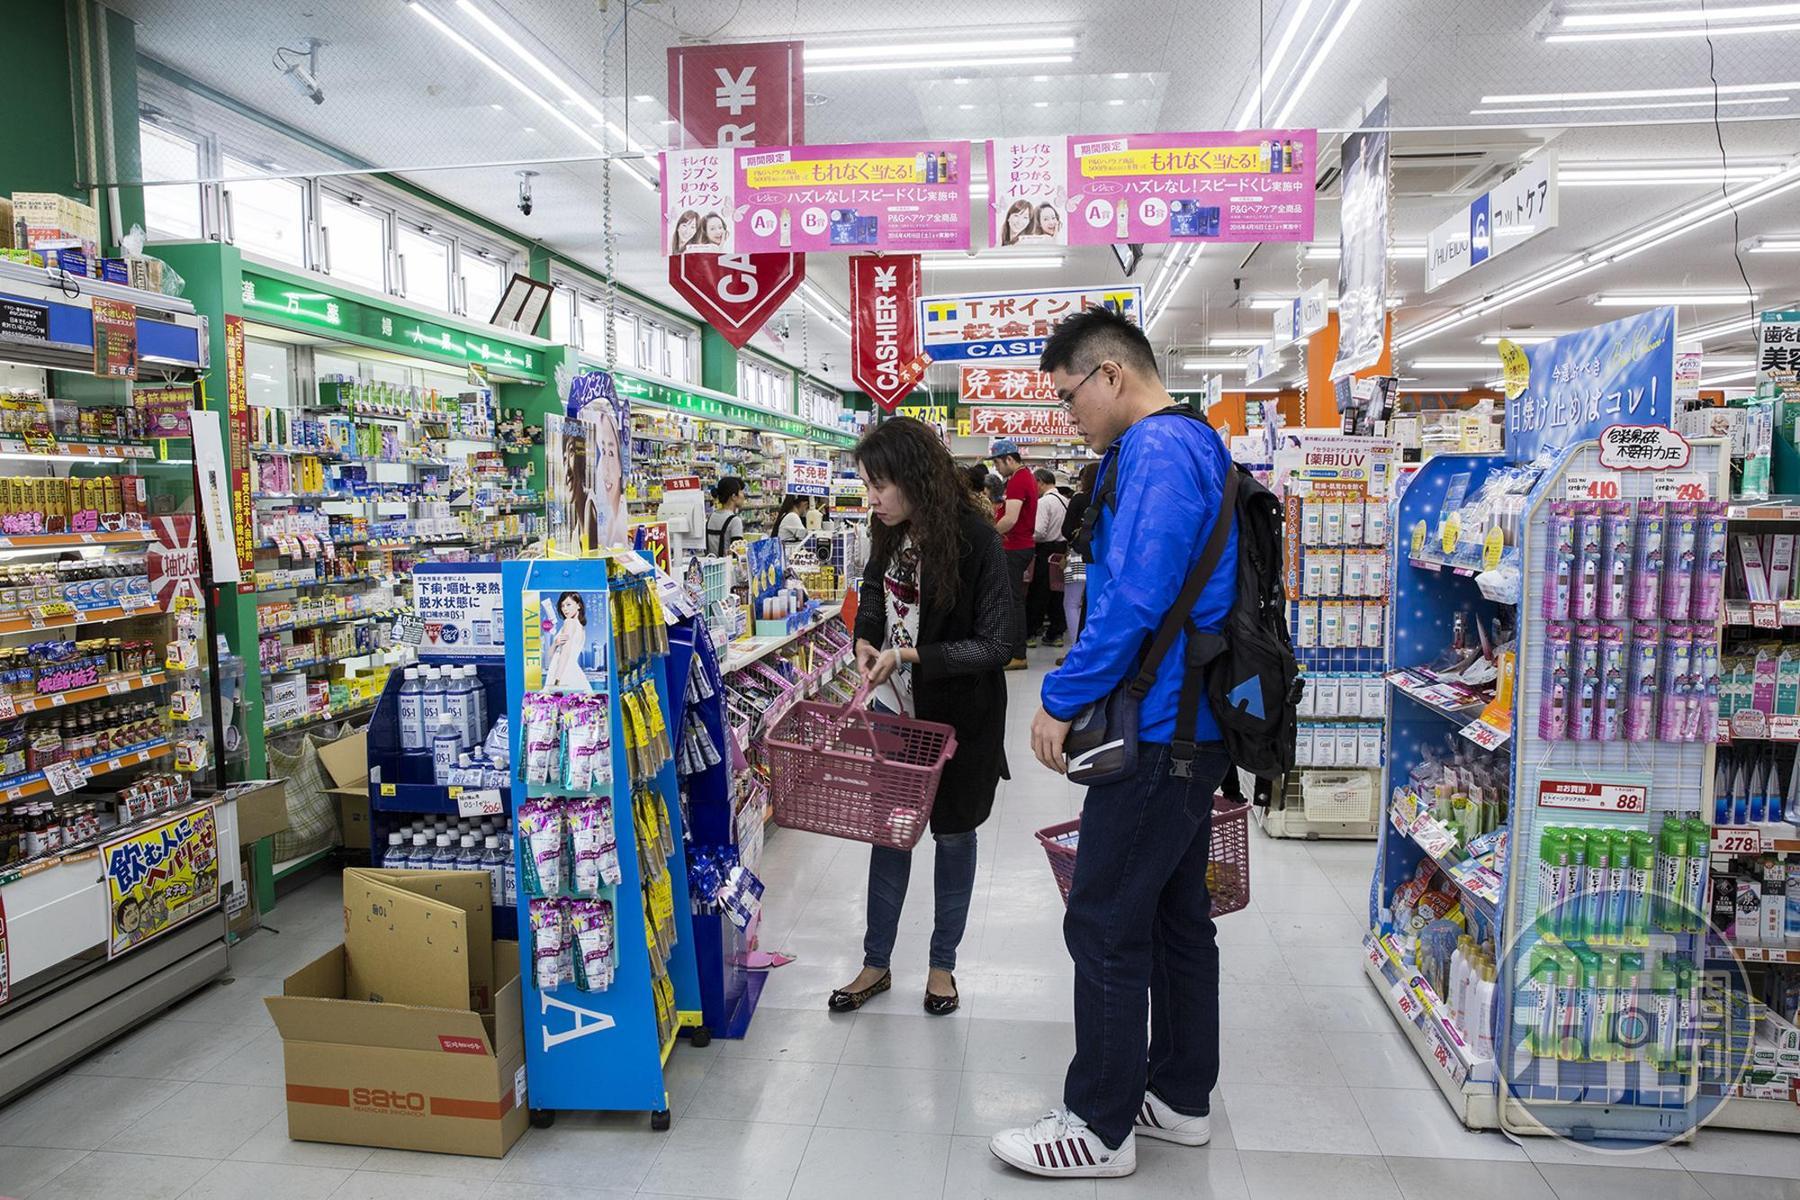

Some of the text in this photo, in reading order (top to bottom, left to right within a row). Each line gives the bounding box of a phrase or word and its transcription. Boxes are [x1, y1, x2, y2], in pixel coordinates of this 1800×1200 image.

[1010, 144, 1050, 155] キレイな
[681, 156, 718, 166] キレイな
[1011, 156, 1050, 169] ジブン
[682, 168, 718, 180] ジブン
[1010, 170, 1051, 181] 見つかる
[681, 182, 719, 193] 見つかる
[1764, 326, 1800, 343] 歯を
[875, 295, 899, 390] CASHIER
[967, 339, 1045, 358] CASH
[964, 369, 1056, 399] 免税 TA
[974, 410, 1029, 433] 免税
[1030, 426, 1076, 435] CASHIER
[795, 485, 825, 494] CASHIER
[1587, 481, 1617, 499] 410
[418, 582, 501, 595] 下痢・嘔吐・発熱
[419, 597, 480, 609] 脱水状態に
[450, 610, 465, 619] OS-1
[524, 608, 541, 666] ALLIE
[1617, 795, 1638, 809] 88
[1724, 837, 1753, 851] 278
[109, 817, 192, 893] 飲む人に
[165, 882, 188, 897] 女子会
[353, 1087, 425, 1112] sato
